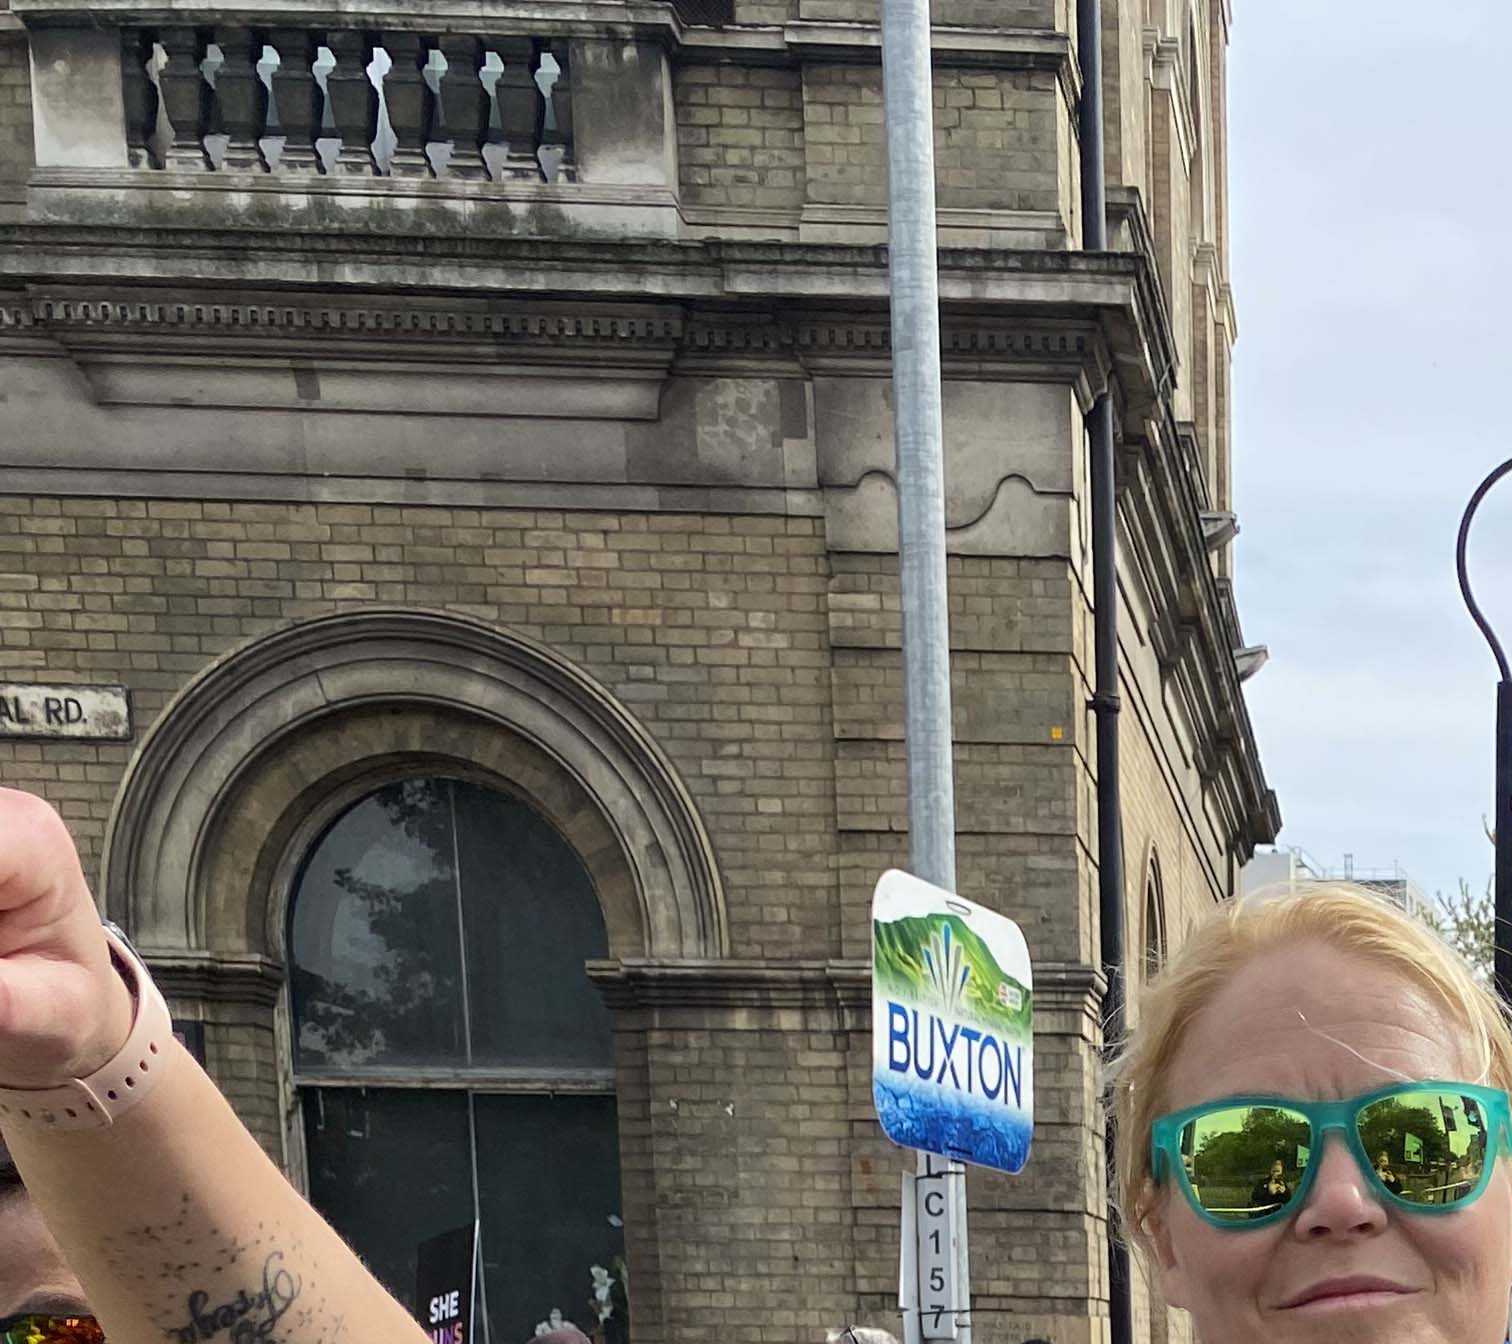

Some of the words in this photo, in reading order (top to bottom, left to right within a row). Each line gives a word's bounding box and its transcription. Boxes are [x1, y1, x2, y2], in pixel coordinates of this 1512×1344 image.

[44, 697, 88, 724] RD.
[888, 1000, 1022, 1110] BUXTON
[429, 1290, 459, 1324] SHE
